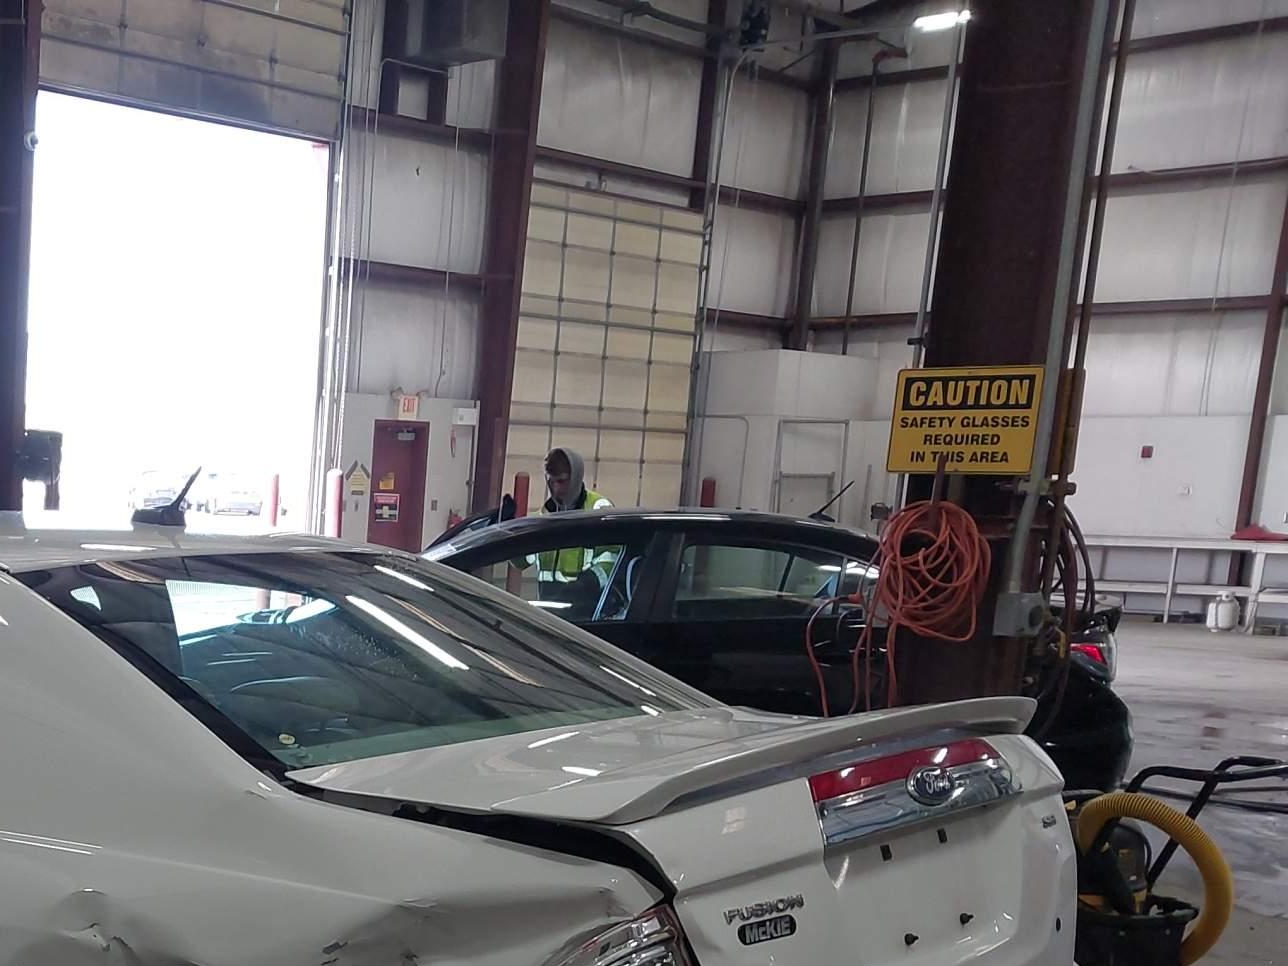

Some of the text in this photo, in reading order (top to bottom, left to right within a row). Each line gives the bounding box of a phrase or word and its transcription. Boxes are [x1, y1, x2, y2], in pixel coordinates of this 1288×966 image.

[908, 379, 1030, 407] CAUTION
[403, 397, 416, 413] EXIT
[900, 415, 1030, 428] SAFETY GLASSES
[923, 433, 1001, 446] REQUIRED
[910, 451, 1009, 463] IN THIS AREA
[922, 770, 951, 794] Ford
[723, 894, 804, 926] FUSION
[745, 916, 791, 944] McKIE
